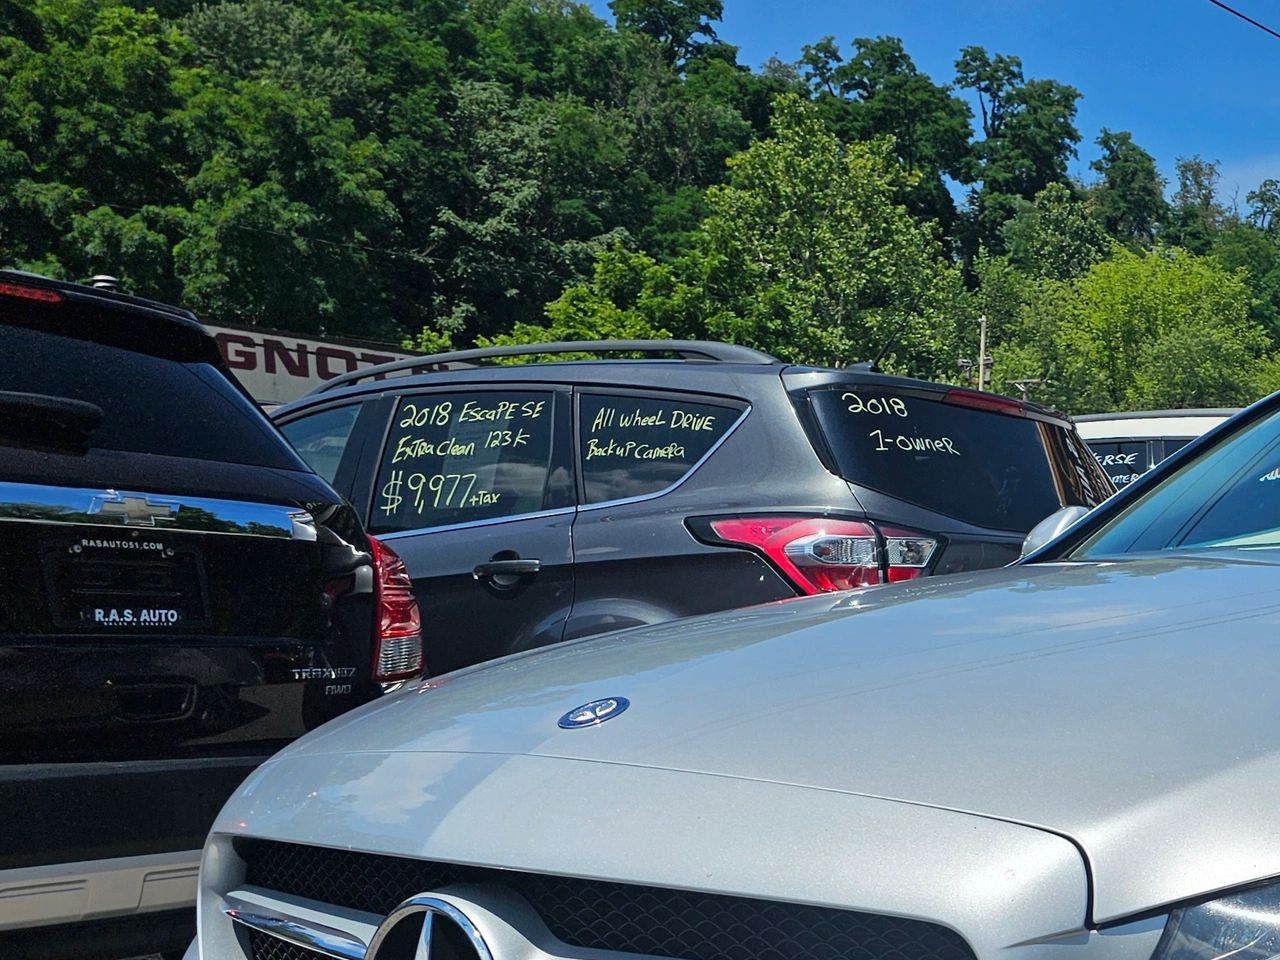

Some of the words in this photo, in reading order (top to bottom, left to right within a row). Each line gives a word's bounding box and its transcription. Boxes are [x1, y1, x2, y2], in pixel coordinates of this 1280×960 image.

[400, 401, 453, 428] 2018
[521, 401, 545, 419] SE
[842, 392, 908, 417] 2018
[591, 407, 615, 432] All
[82, 539, 164, 550] RASAUTO51.COM
[94, 608, 137, 622] R.A.S.
[140, 609, 178, 622] AUTO
